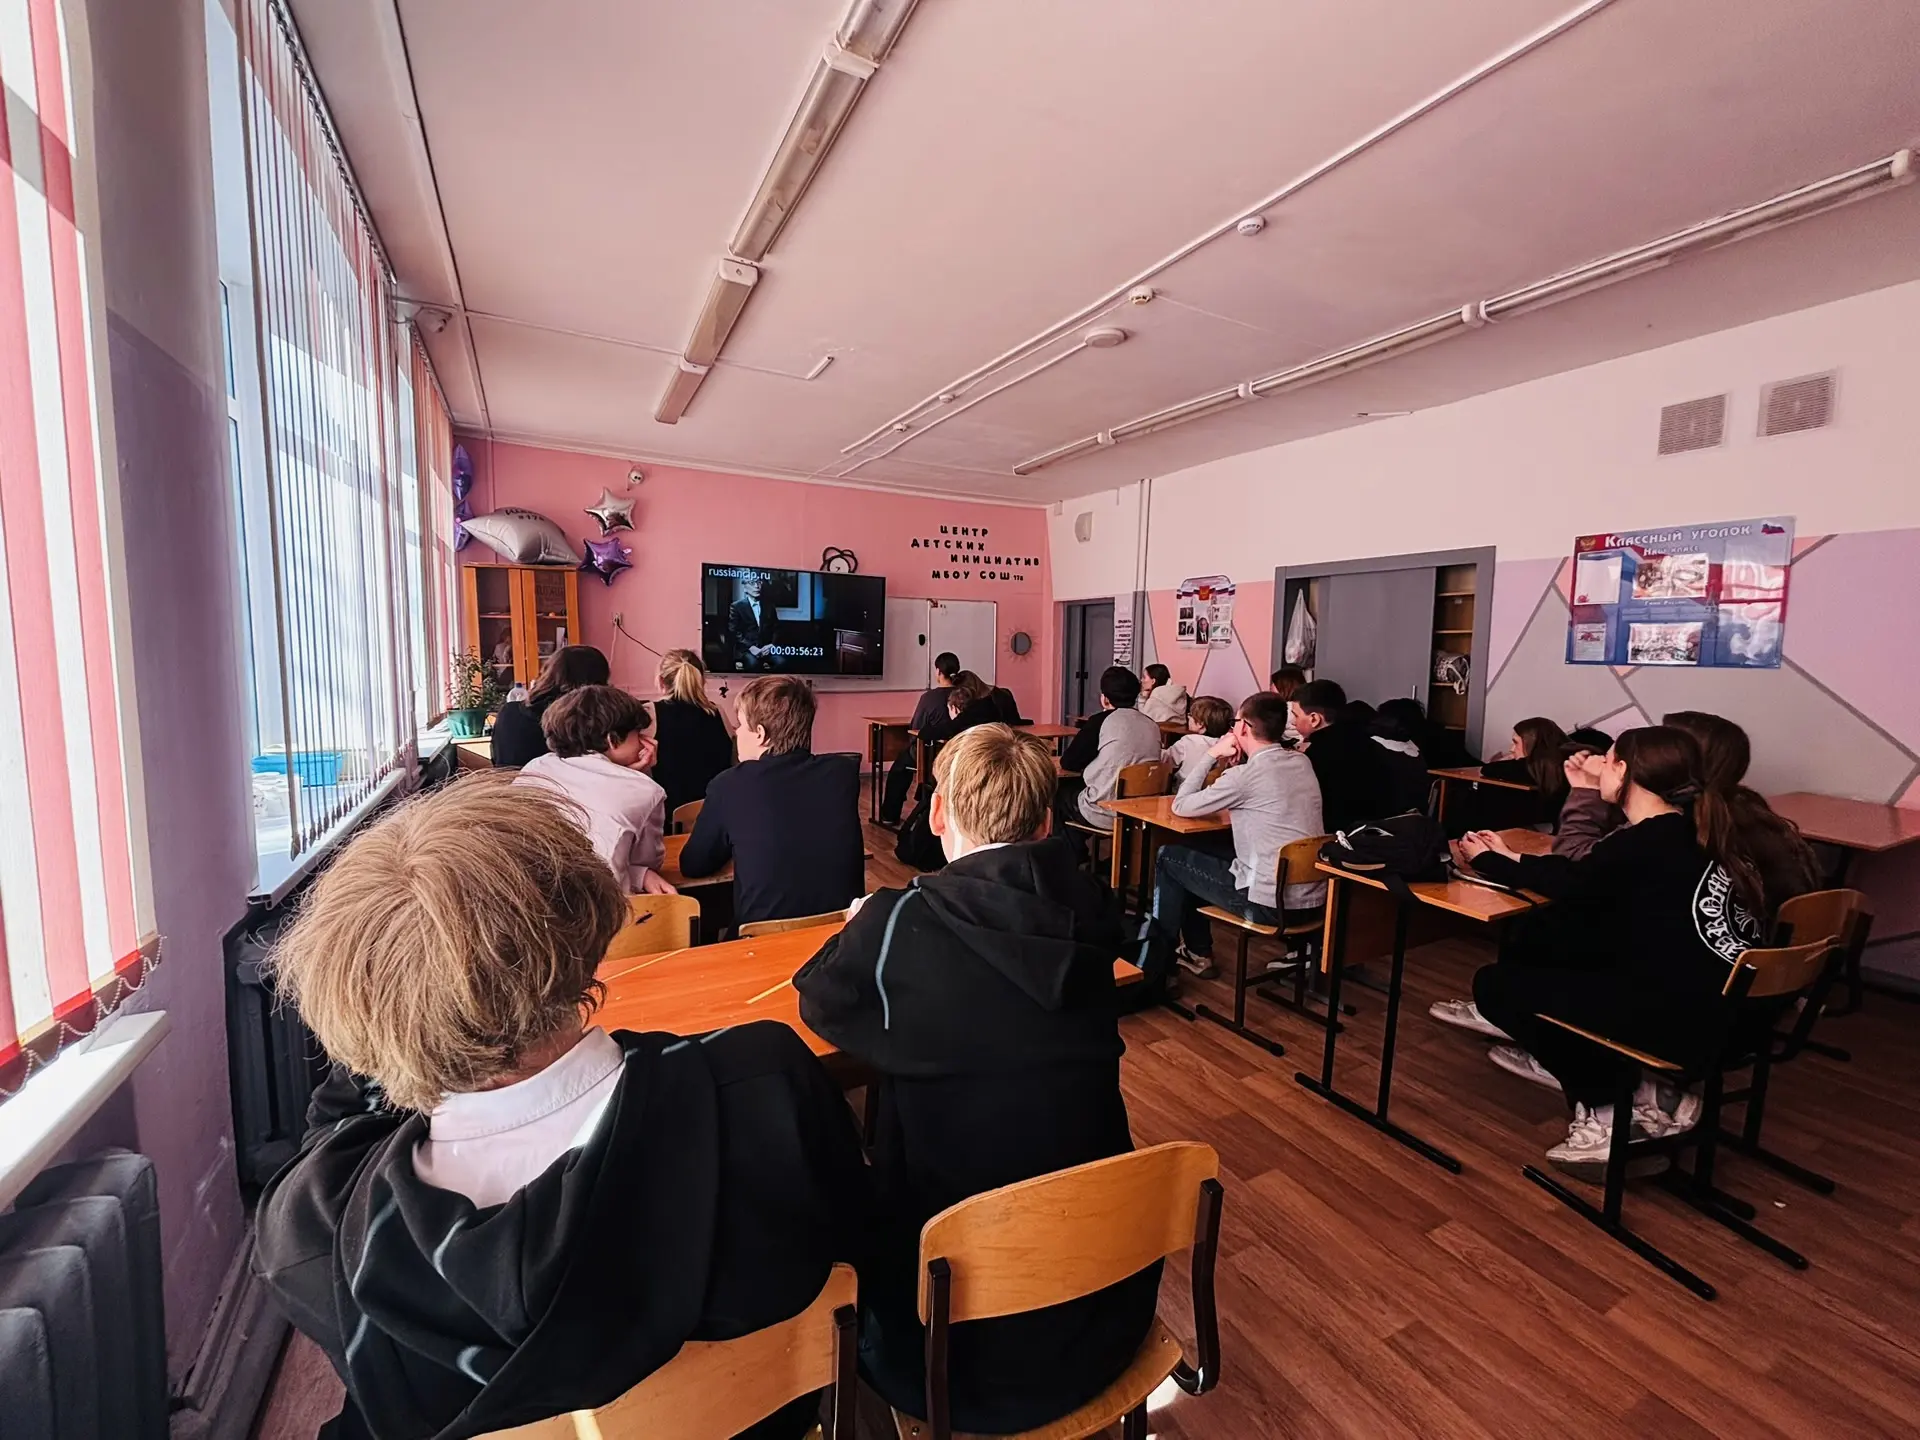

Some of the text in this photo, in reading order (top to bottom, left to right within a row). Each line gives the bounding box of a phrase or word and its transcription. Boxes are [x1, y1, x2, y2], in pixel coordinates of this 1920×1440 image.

[940, 525, 988, 537] ЦЕНТР
[1604, 525, 1751, 547] Классный уголок
[911, 538, 985, 551] ДЕТСКИХ
[950, 554, 1039, 566] ИНИЦИАТИВ
[932, 570, 970, 579] МБОУ
[980, 570, 1010, 580] СОШ
[770, 646, 824, 656] 00:03:56:23
